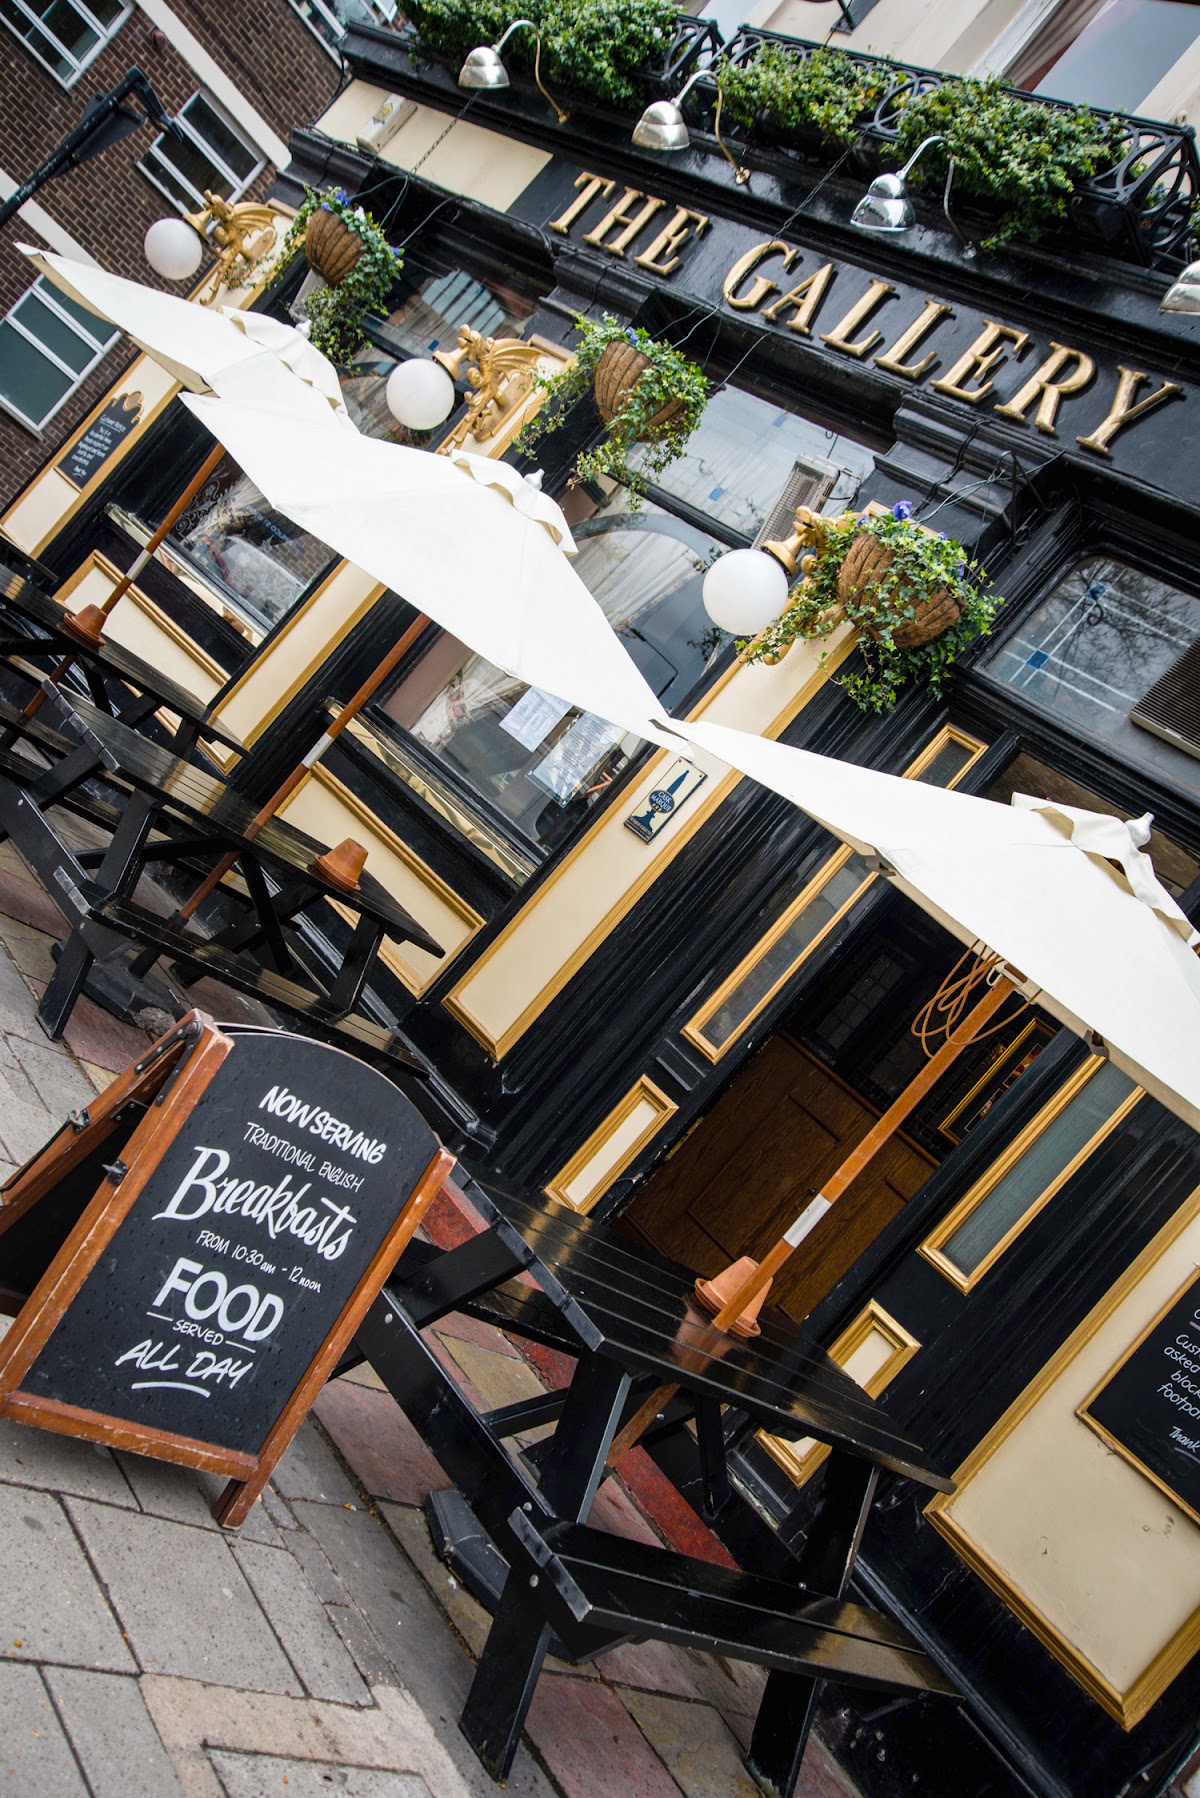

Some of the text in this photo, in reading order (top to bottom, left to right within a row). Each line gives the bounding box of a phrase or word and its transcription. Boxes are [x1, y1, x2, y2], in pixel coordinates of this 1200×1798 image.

[548, 171, 1184, 455] THE GALLERY
[650, 793, 672, 812] MARQUE
[658, 791, 671, 804] CASK
[243, 1122, 365, 1193] TRADITIONAL ENGLISH
[151, 1145, 358, 1261] Breakfasts
[195, 1230, 230, 1254] FROM
[152, 1256, 284, 1342] FOOD
[172, 1319, 224, 1346] SERVED
[1175, 1334, 1200, 1358] Cust
[115, 1339, 253, 1389] ALL DAY
[1156, 1382, 1200, 1420] footpa
[1169, 1425, 1200, 1453] Thank
